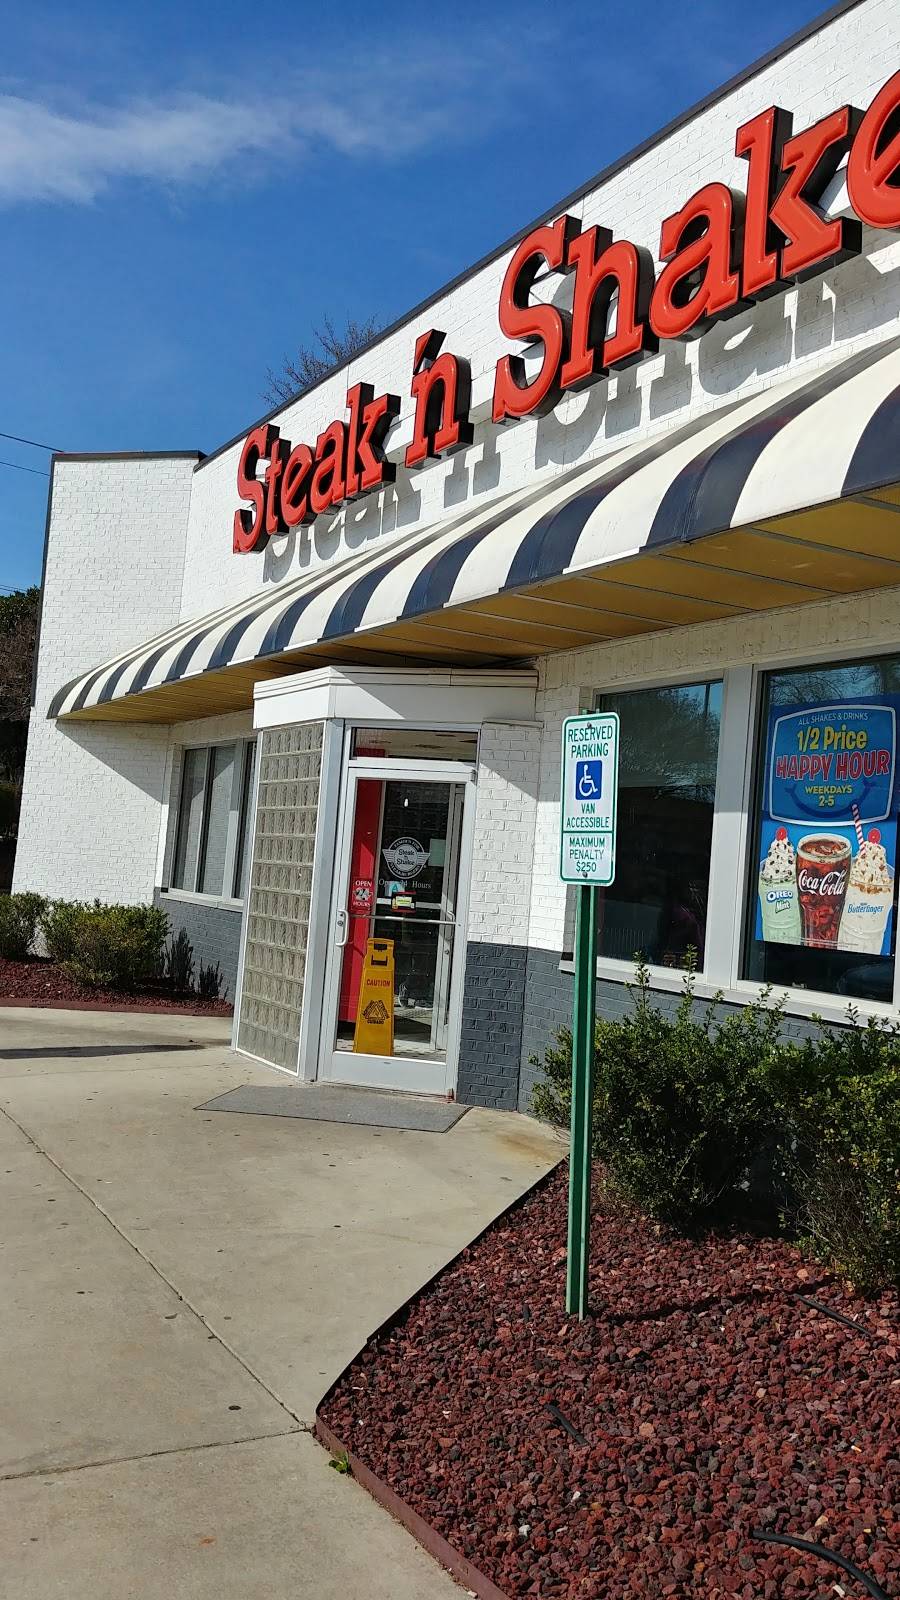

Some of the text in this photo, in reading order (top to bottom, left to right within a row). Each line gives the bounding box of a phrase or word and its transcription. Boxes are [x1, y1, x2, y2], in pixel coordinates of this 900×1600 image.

[231, 382, 400, 555] Steak
[491, 69, 900, 424] Shake
[811, 713, 837, 723] SHAKES
[838, 712, 843, 721] &
[843, 712, 869, 721] DRINKS
[568, 726, 613, 742] RESERVED
[797, 724, 868, 752] 1/2 Price
[571, 743, 609, 758] PARKING
[776, 750, 891, 781] HAPPY HOUR
[805, 785, 853, 795] WEEKDAYS
[818, 796, 835, 807] 2-5
[581, 803, 596, 814] VAN
[567, 816, 610, 828] ACCESSIBLE
[569, 837, 605, 847] MAXIMUM
[398, 848, 415, 856] Steak
[569, 849, 604, 860] PENALTY
[576, 861, 597, 873] $250
[355, 880, 372, 888] OPEN
[412, 880, 432, 889] Hours
[767, 891, 793, 902] OREO
[775, 901, 791, 913] Mint
[847, 903, 884, 914] Butterfinger
[367, 979, 391, 987] CAUTION
